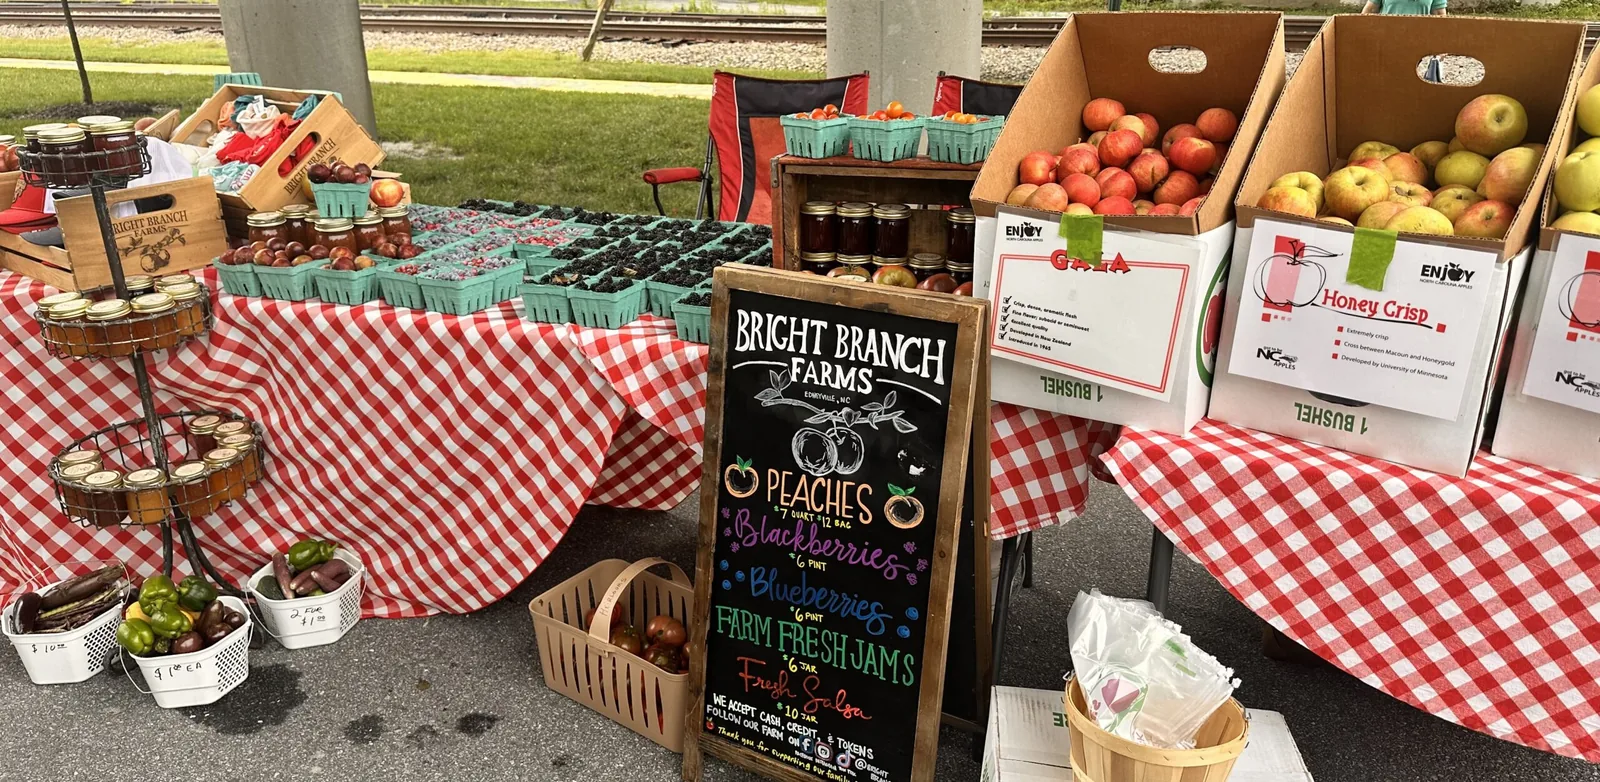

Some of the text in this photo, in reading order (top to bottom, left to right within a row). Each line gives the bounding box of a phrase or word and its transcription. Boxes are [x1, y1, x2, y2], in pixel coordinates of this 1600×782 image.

[284, 165, 308, 195] BRIGHT
[113, 210, 188, 234] RIGHT BRANCH
[134, 225, 167, 238] FARMS
[1013, 300, 1026, 308] Crisp,
[1043, 308, 1064, 317] aromatic
[1322, 288, 1429, 325] Honey Crisp
[1011, 318, 1048, 332] Excellent quality
[1063, 322, 1090, 332] semisweet
[1346, 327, 1389, 341] Extremely crisp
[735, 309, 946, 385] BRIGHT BRANCH
[1008, 336, 1033, 347] Introduced
[1009, 327, 1034, 338] Developed
[1052, 338, 1072, 347] Zealand
[1256, 347, 1282, 362] NC
[1344, 341, 1359, 349] Cross
[1360, 344, 1385, 354] between
[1385, 349, 1408, 359] Macoun
[1422, 356, 1456, 367] Honeygold
[791, 357, 873, 394] FARMS
[1273, 361, 1296, 371] APPLES
[1341, 354, 1371, 366] Developed
[1372, 360, 1380, 368] by
[1380, 362, 1409, 374] University
[1417, 369, 1449, 380] Minnesota
[1040, 376, 1092, 400] BUSHEL
[1555, 371, 1585, 388] NC
[1294, 402, 1368, 435] 1 BUSHEL
[767, 469, 873, 524] PEACHES
[791, 510, 815, 522] QUART
[834, 519, 852, 529] BAG
[735, 508, 910, 580] Blackberries
[808, 559, 827, 572] PINT
[751, 566, 893, 635] Blueberries
[290, 608, 302, 619] 2
[805, 612, 824, 623] PINT
[715, 605, 915, 686] FARM FRESH JAMS
[186, 661, 202, 672] EA
[799, 661, 818, 674] JAR
[737, 656, 873, 720] Fresh Salsa
[706, 704, 742, 725] FOLLOW
[743, 719, 759, 732] OUR
[762, 725, 784, 741] FARM
[788, 736, 800, 747] ON
[713, 693, 727, 707] WE
[728, 699, 757, 718] ACCEPT
[760, 711, 785, 730] CASH,
[787, 722, 821, 742] CREDIT,
[837, 737, 874, 759] TOKENS
[800, 712, 818, 724] JAR
[718, 726, 740, 741] Thank
[741, 737, 754, 746] you
[757, 741, 769, 752] for
[771, 748, 811, 771] supporting
[813, 765, 826, 776] our
